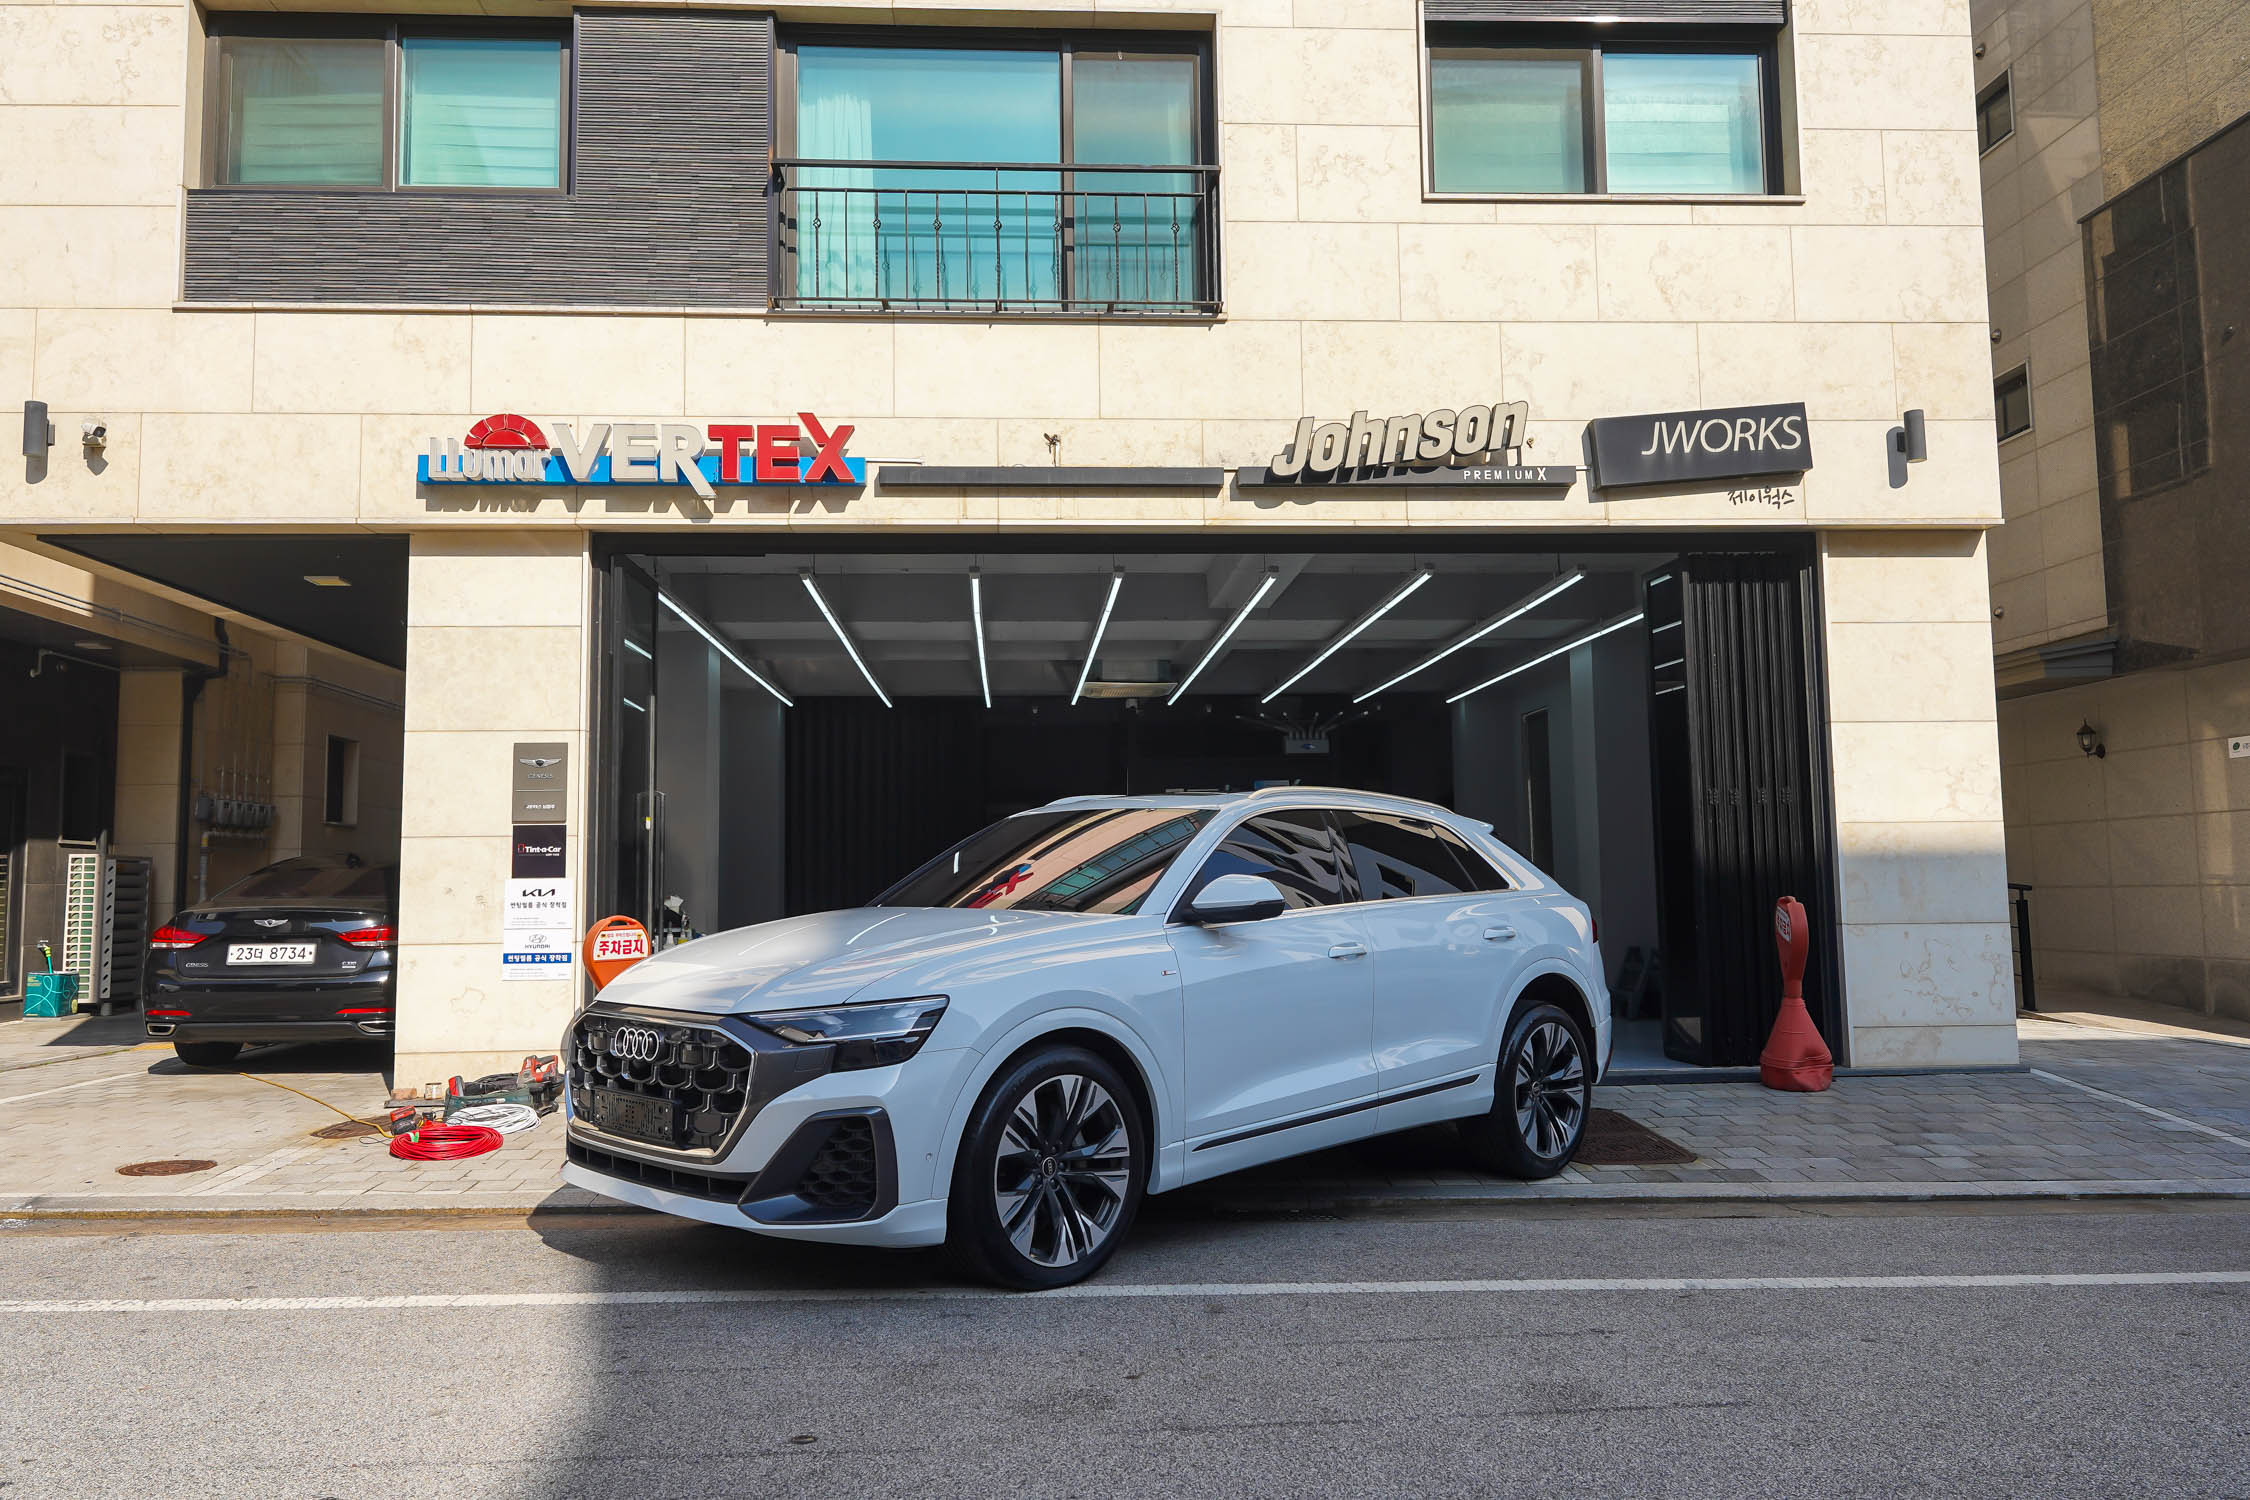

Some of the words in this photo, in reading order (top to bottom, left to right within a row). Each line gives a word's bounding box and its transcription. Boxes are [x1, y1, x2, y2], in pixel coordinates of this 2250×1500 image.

[1271, 400, 1529, 476] Johnson
[1642, 415, 1802, 456] JWORKS
[551, 412, 856, 499] VERTEX
[522, 888, 556, 897] KIA
[236, 947, 263, 960] 23더
[269, 946, 306, 960] 8734
[599, 939, 645, 955] 주차금지
